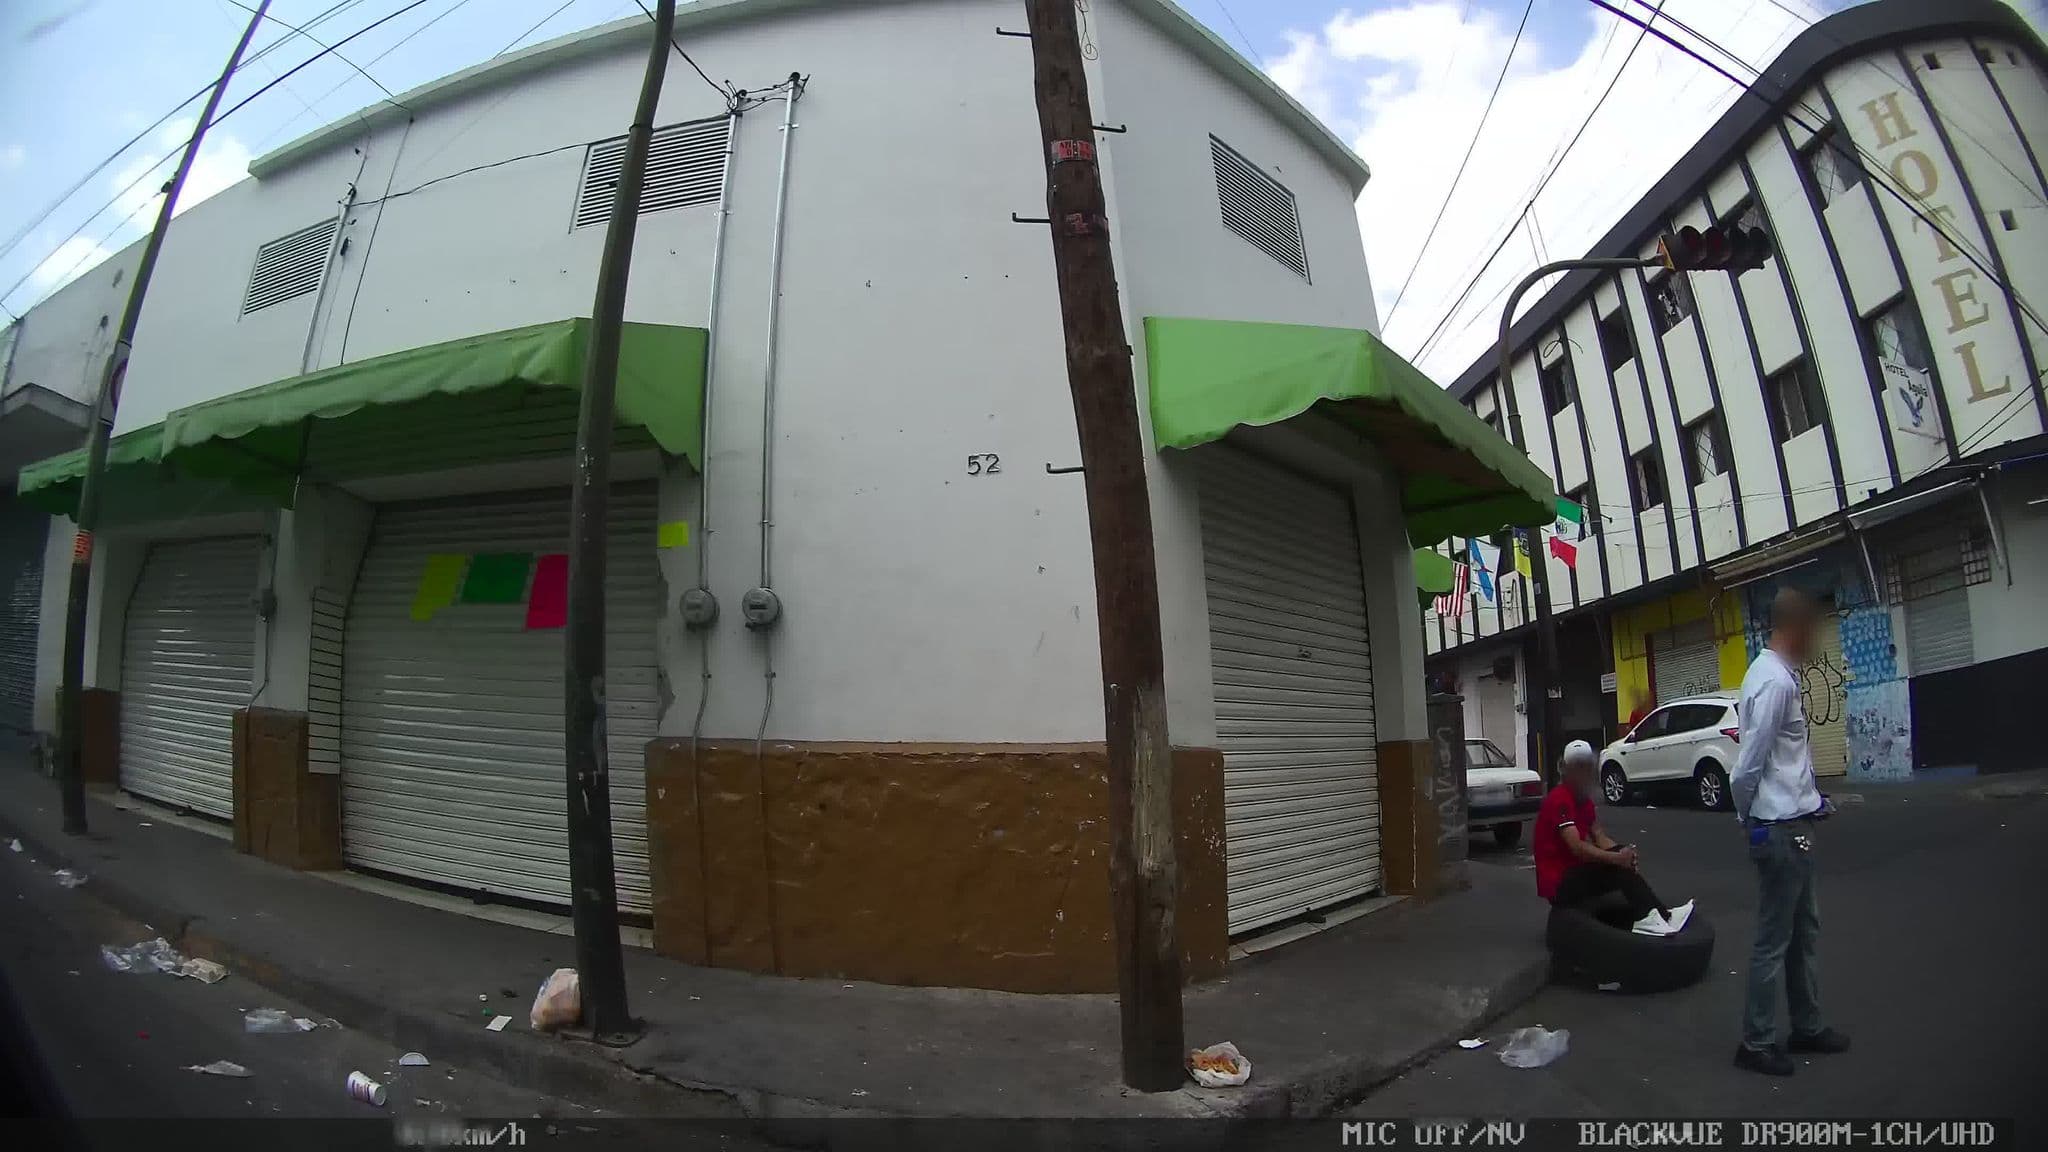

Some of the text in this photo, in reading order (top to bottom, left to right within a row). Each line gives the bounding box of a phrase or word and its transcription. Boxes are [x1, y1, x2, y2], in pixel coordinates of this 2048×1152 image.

[1858, 90, 2012, 404] HOTEL
[1884, 361, 1910, 379] HOTEL
[968, 453, 1000, 475] 52
